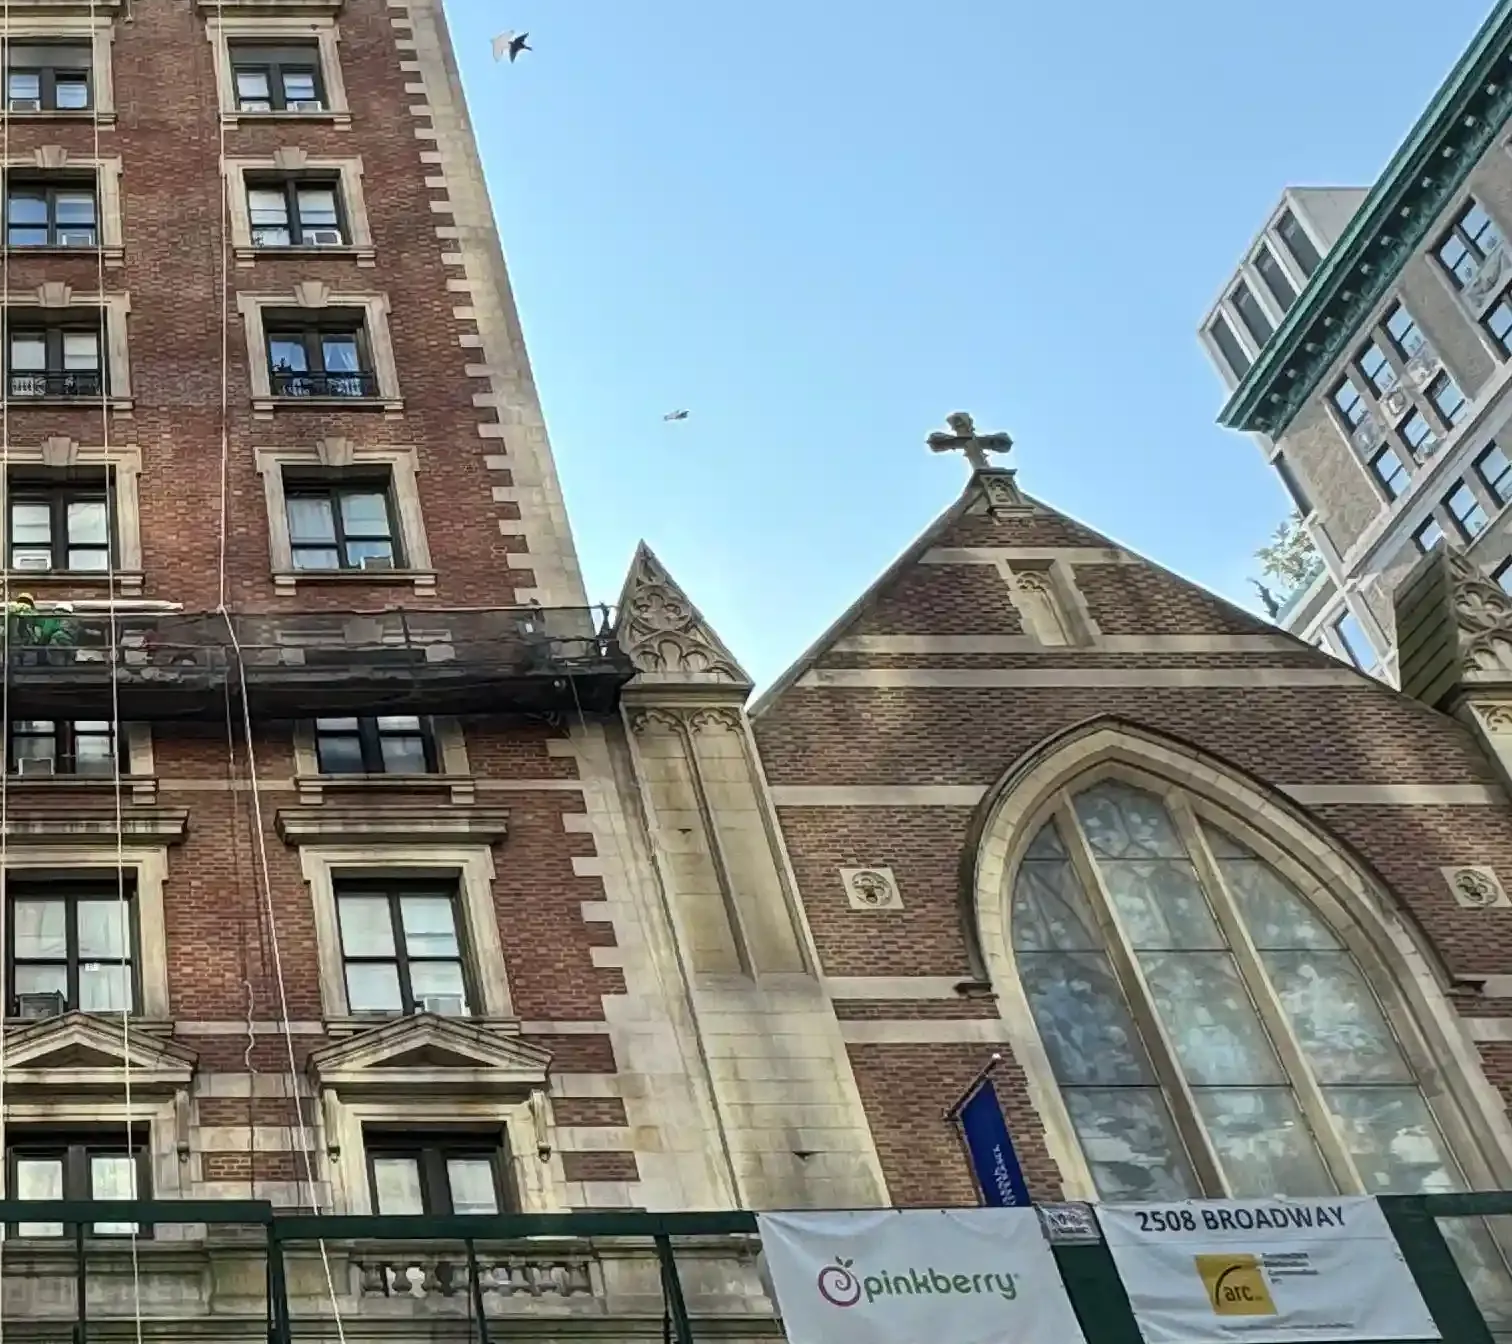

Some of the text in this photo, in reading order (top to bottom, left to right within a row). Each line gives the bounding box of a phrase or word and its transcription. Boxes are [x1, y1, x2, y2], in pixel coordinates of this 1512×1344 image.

[1135, 1206, 1346, 1232] 2508 BROADWAY
[864, 1267, 1018, 1304] pinkberry
[1224, 1284, 1254, 1303] arc
